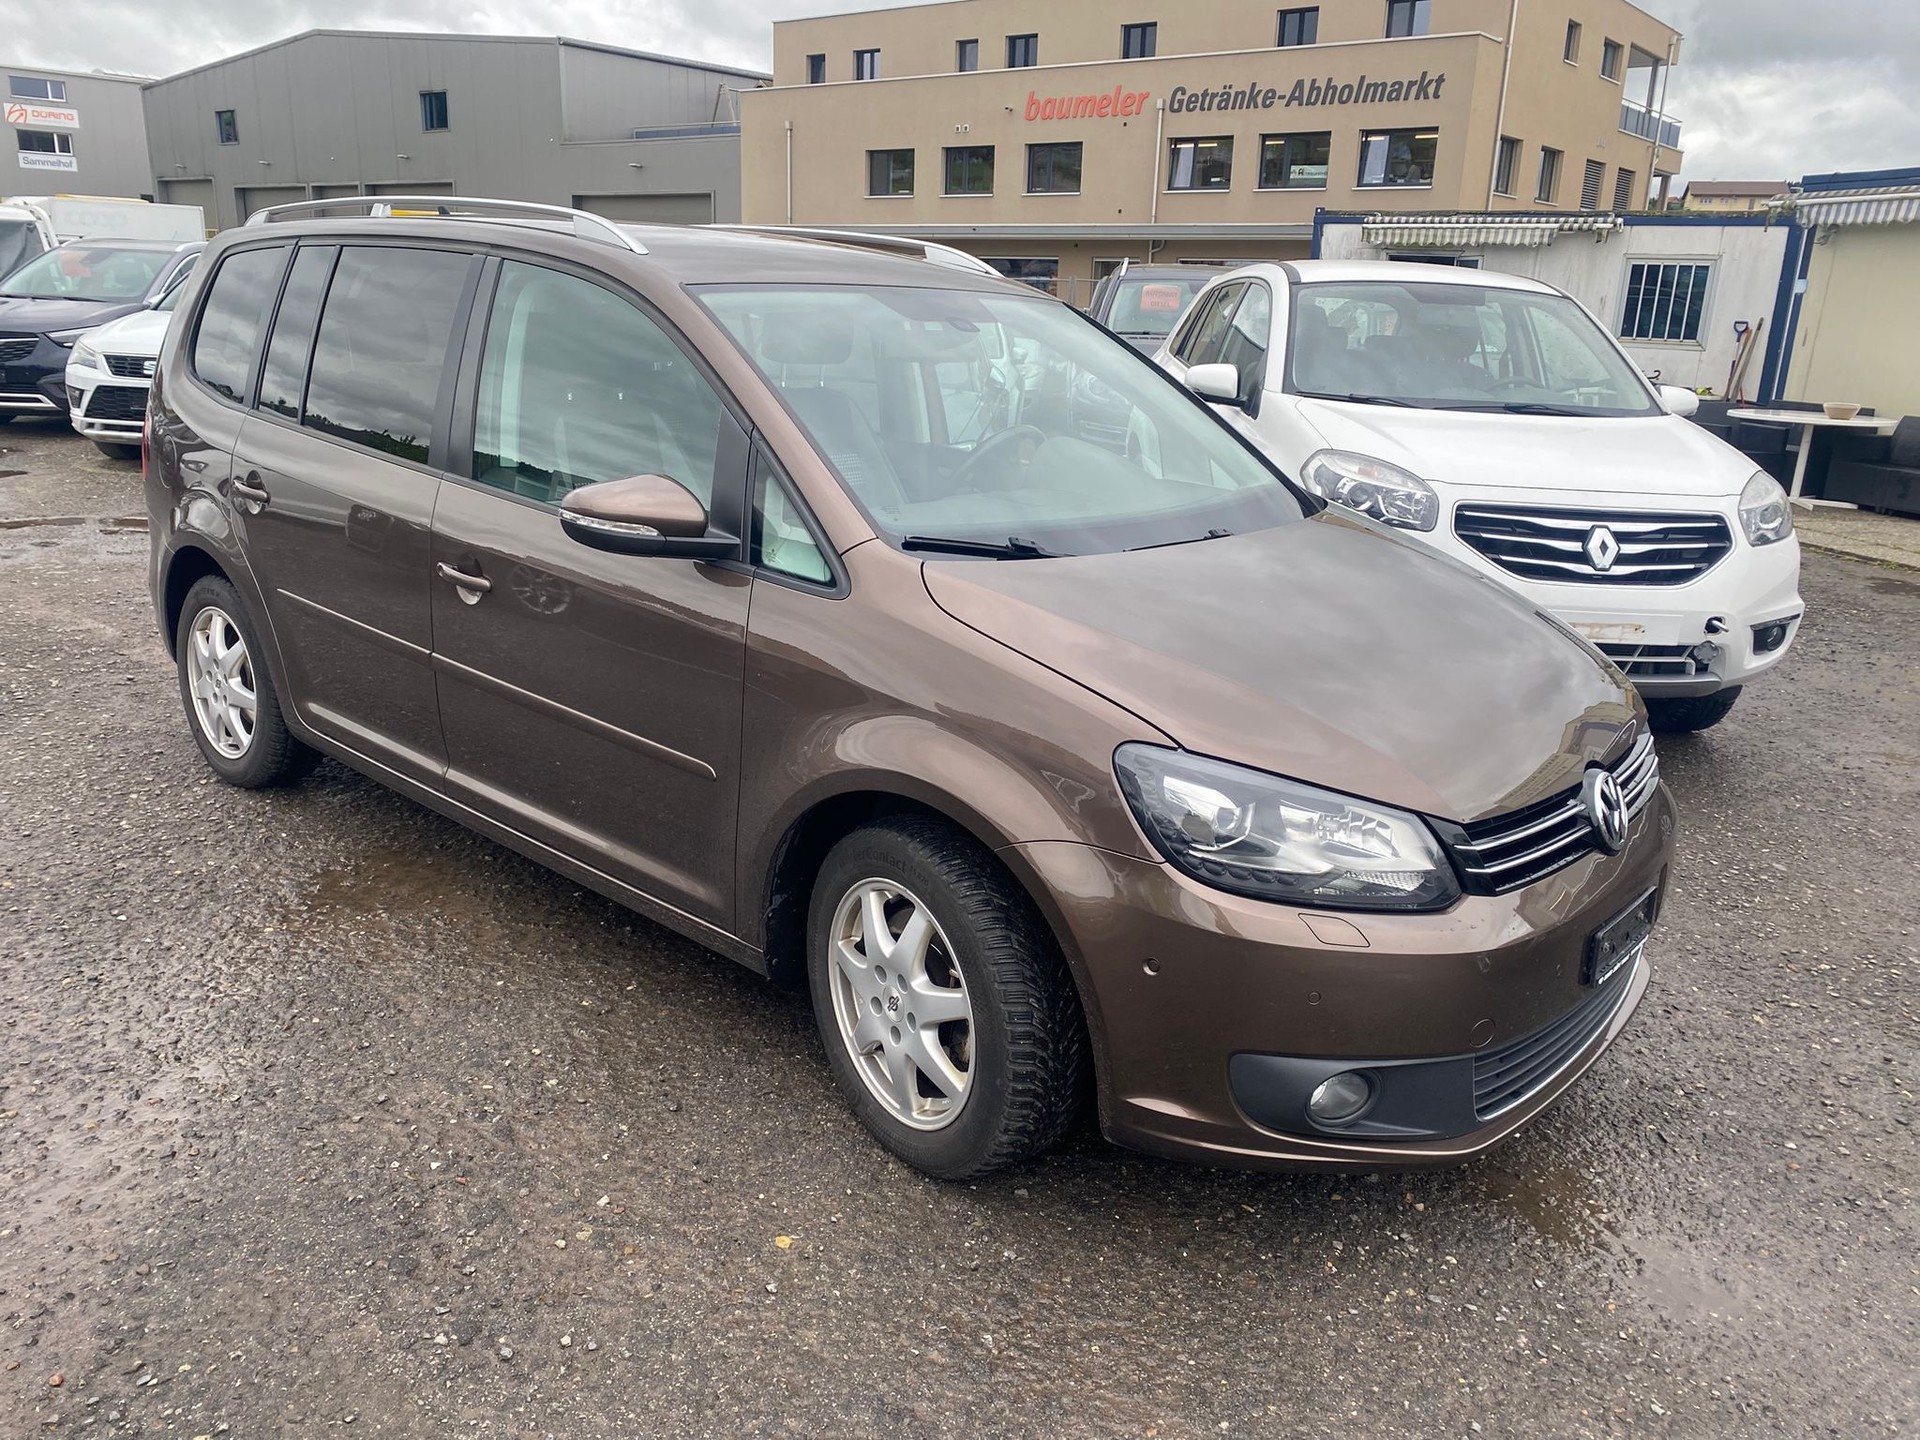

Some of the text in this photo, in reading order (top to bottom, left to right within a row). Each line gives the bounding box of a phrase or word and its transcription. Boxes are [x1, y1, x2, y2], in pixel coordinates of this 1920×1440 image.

[1024, 70, 1446, 121] baumeler Getränke-Abholmarkt
[22, 156, 73, 169] Sammelhof
